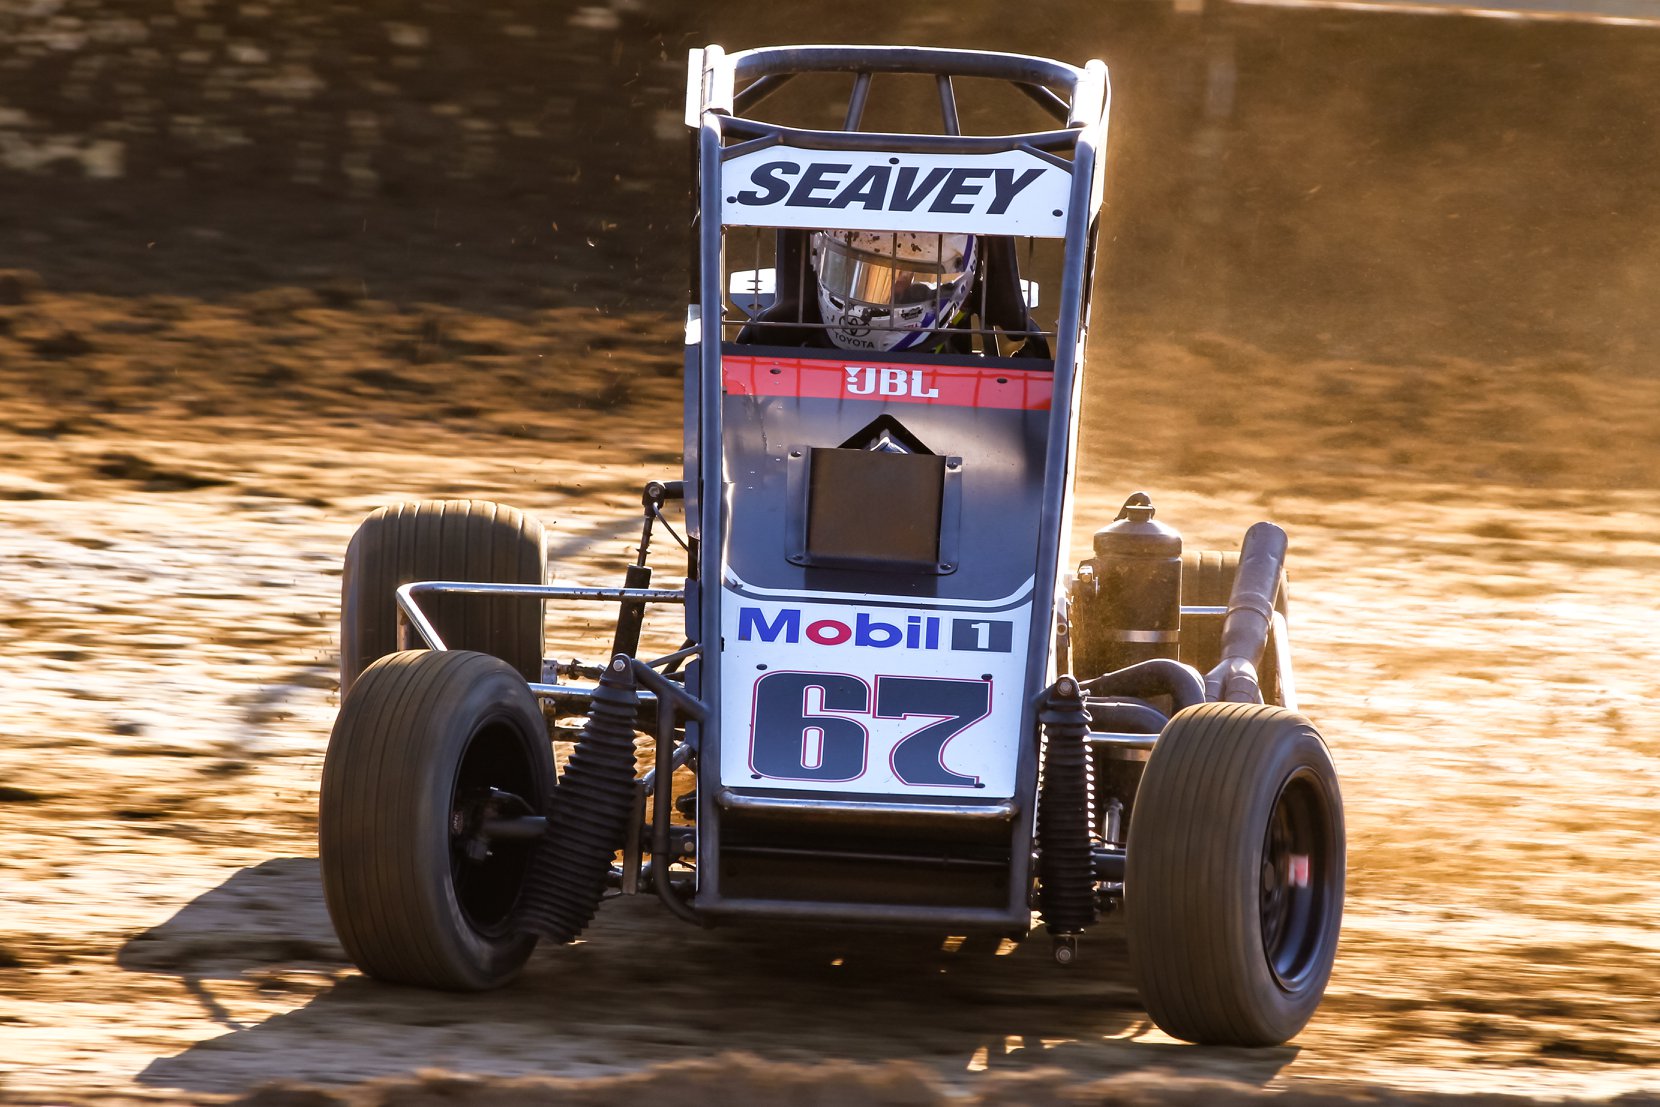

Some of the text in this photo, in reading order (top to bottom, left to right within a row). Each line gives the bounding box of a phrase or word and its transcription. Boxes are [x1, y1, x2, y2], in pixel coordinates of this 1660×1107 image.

[737, 161, 1047, 215] SEAVEY
[834, 331, 875, 349] TOYOTA
[846, 367, 939, 398] JBL
[738, 607, 940, 650] Mobil
[748, 670, 993, 788] 67
